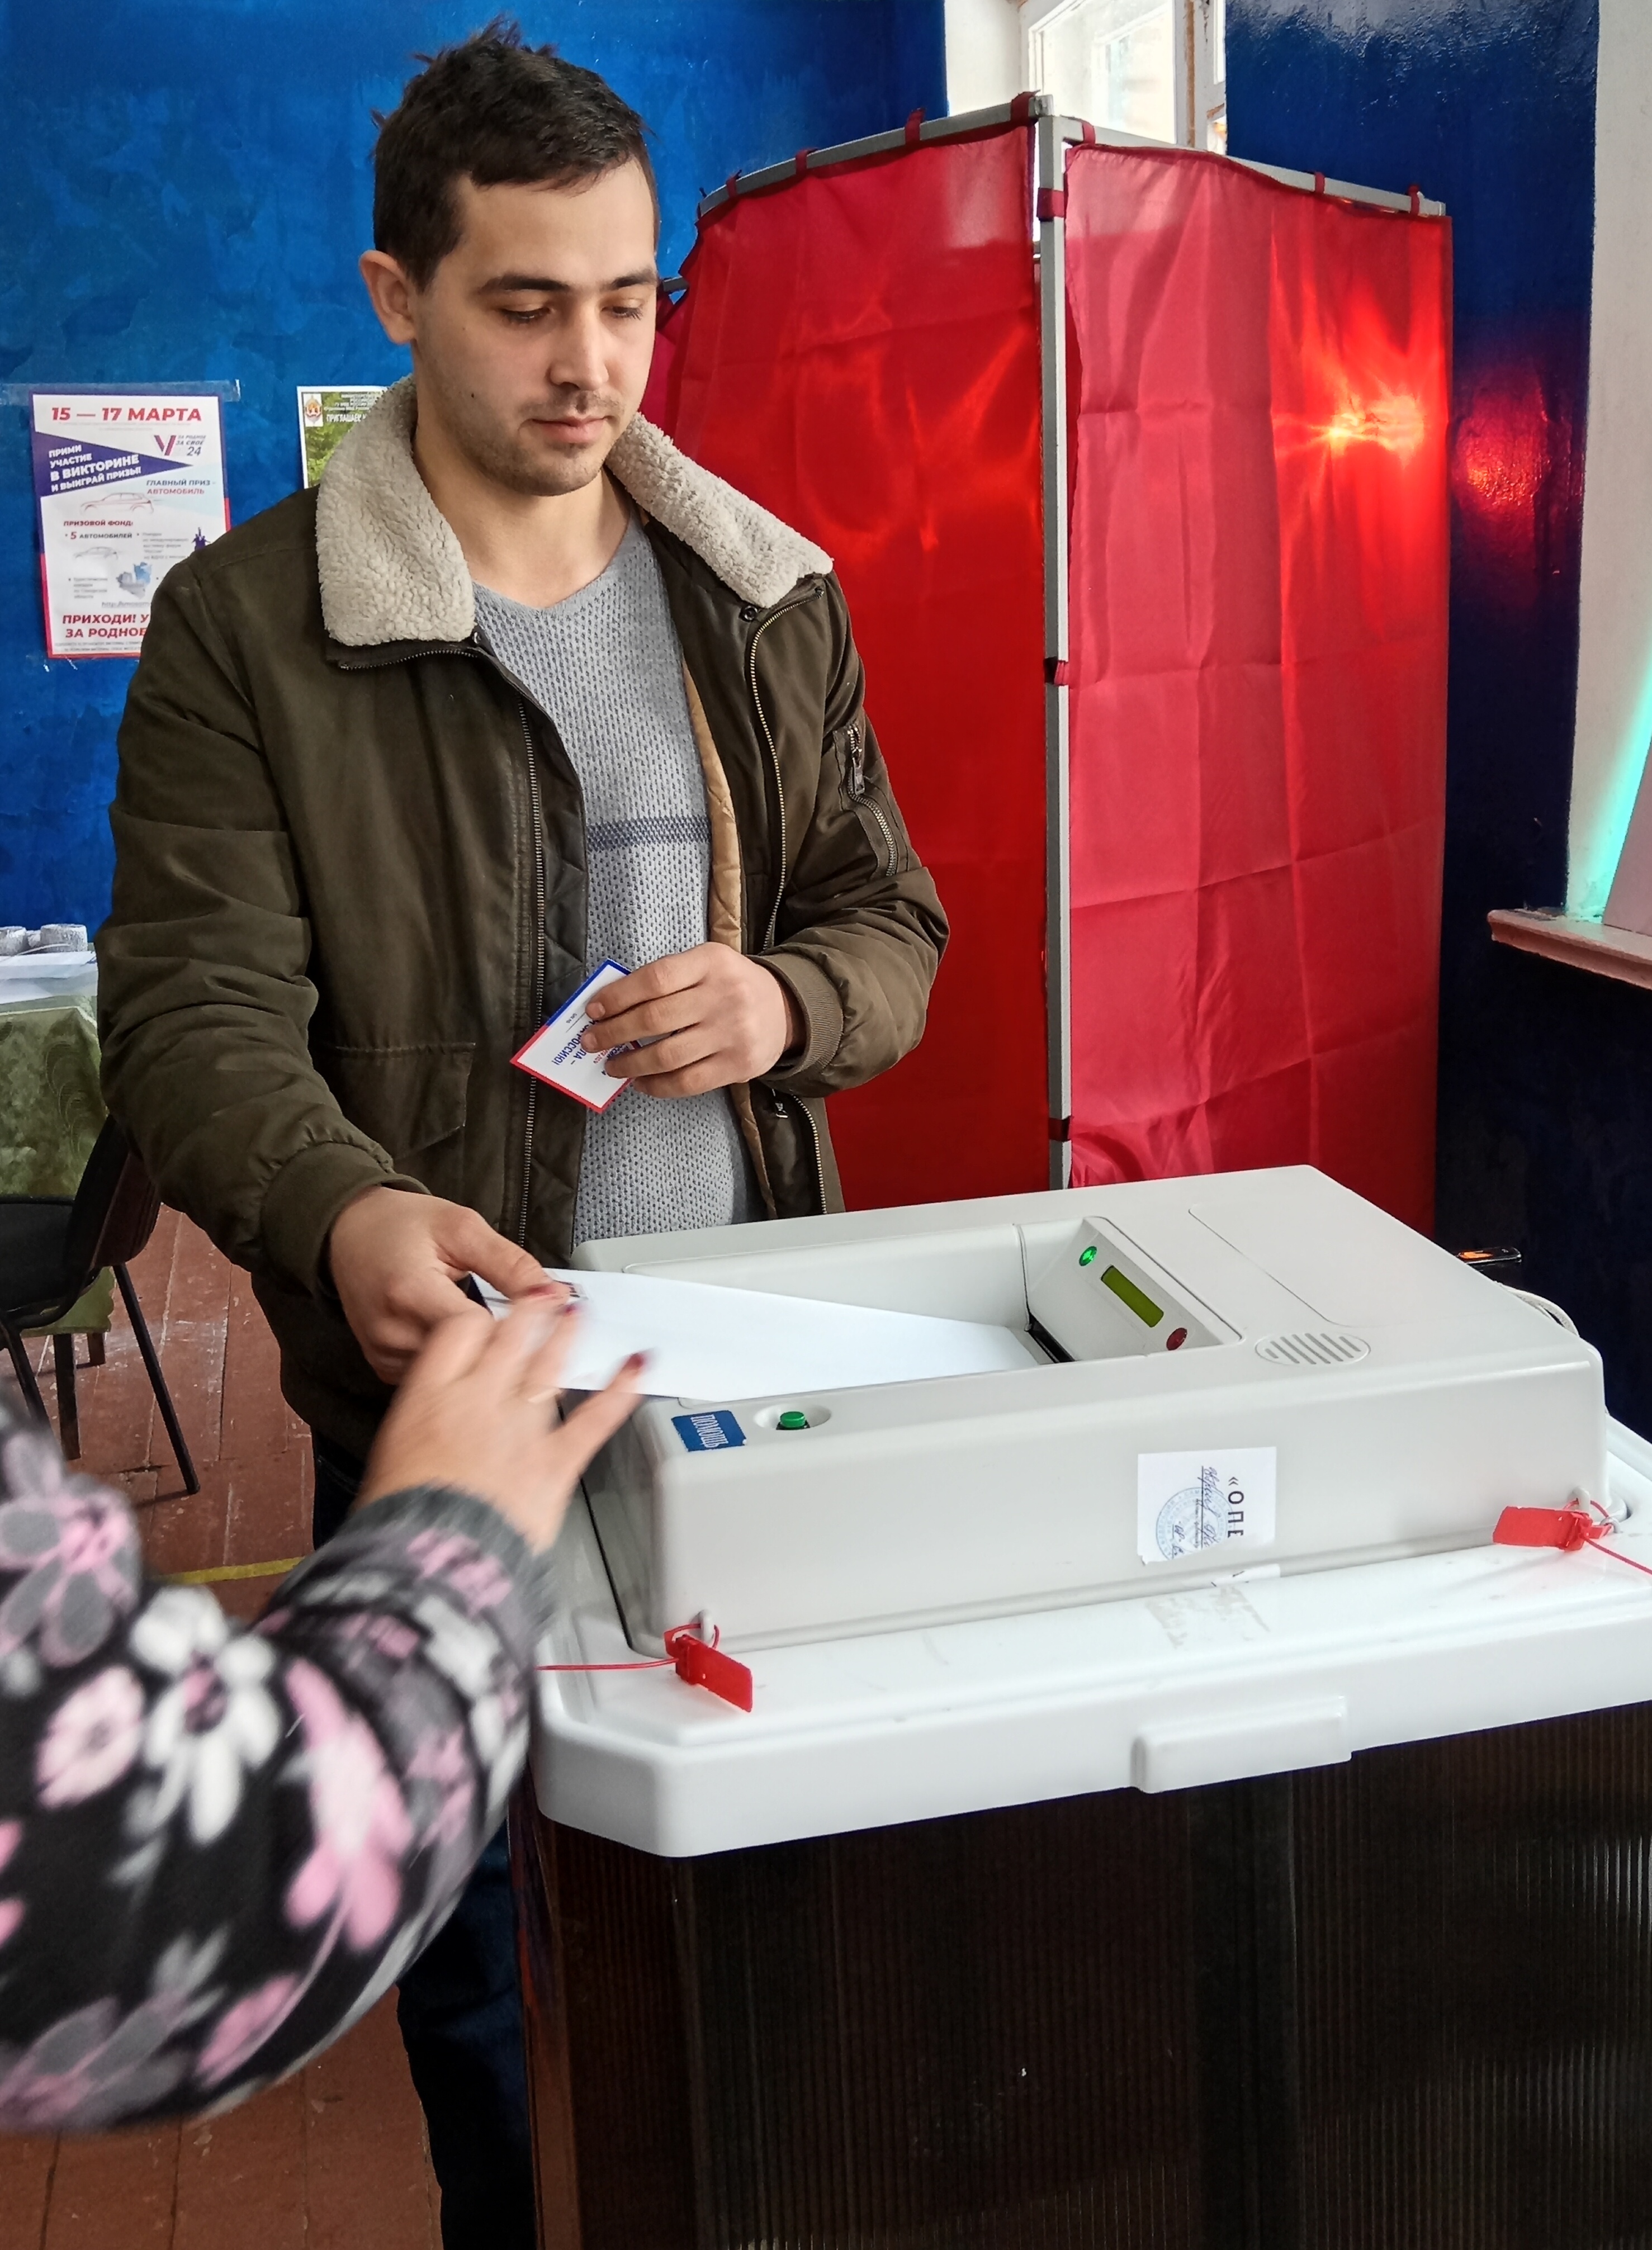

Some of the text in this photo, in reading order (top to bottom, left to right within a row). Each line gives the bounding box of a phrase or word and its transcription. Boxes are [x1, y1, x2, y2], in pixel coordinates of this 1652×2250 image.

[51, 407, 71, 421] 15
[102, 408, 122, 421] 17
[127, 408, 202, 421] МАРТА
[49, 444, 82, 458] ПРИМИ
[187, 446, 202, 456] 24
[50, 453, 92, 468] УЧАСТИЕ
[50, 454, 140, 482] В ВИКТОРИНЕ
[51, 484, 59, 492] И
[60, 473, 105, 491] ВЫИГРАЙ
[70, 532, 77, 540] 5
[63, 614, 150, 625] ПРИХОДИ! У
[65, 628, 83, 638] ЗА
[690, 1414, 729, 1448] ПОМОЩЬ
